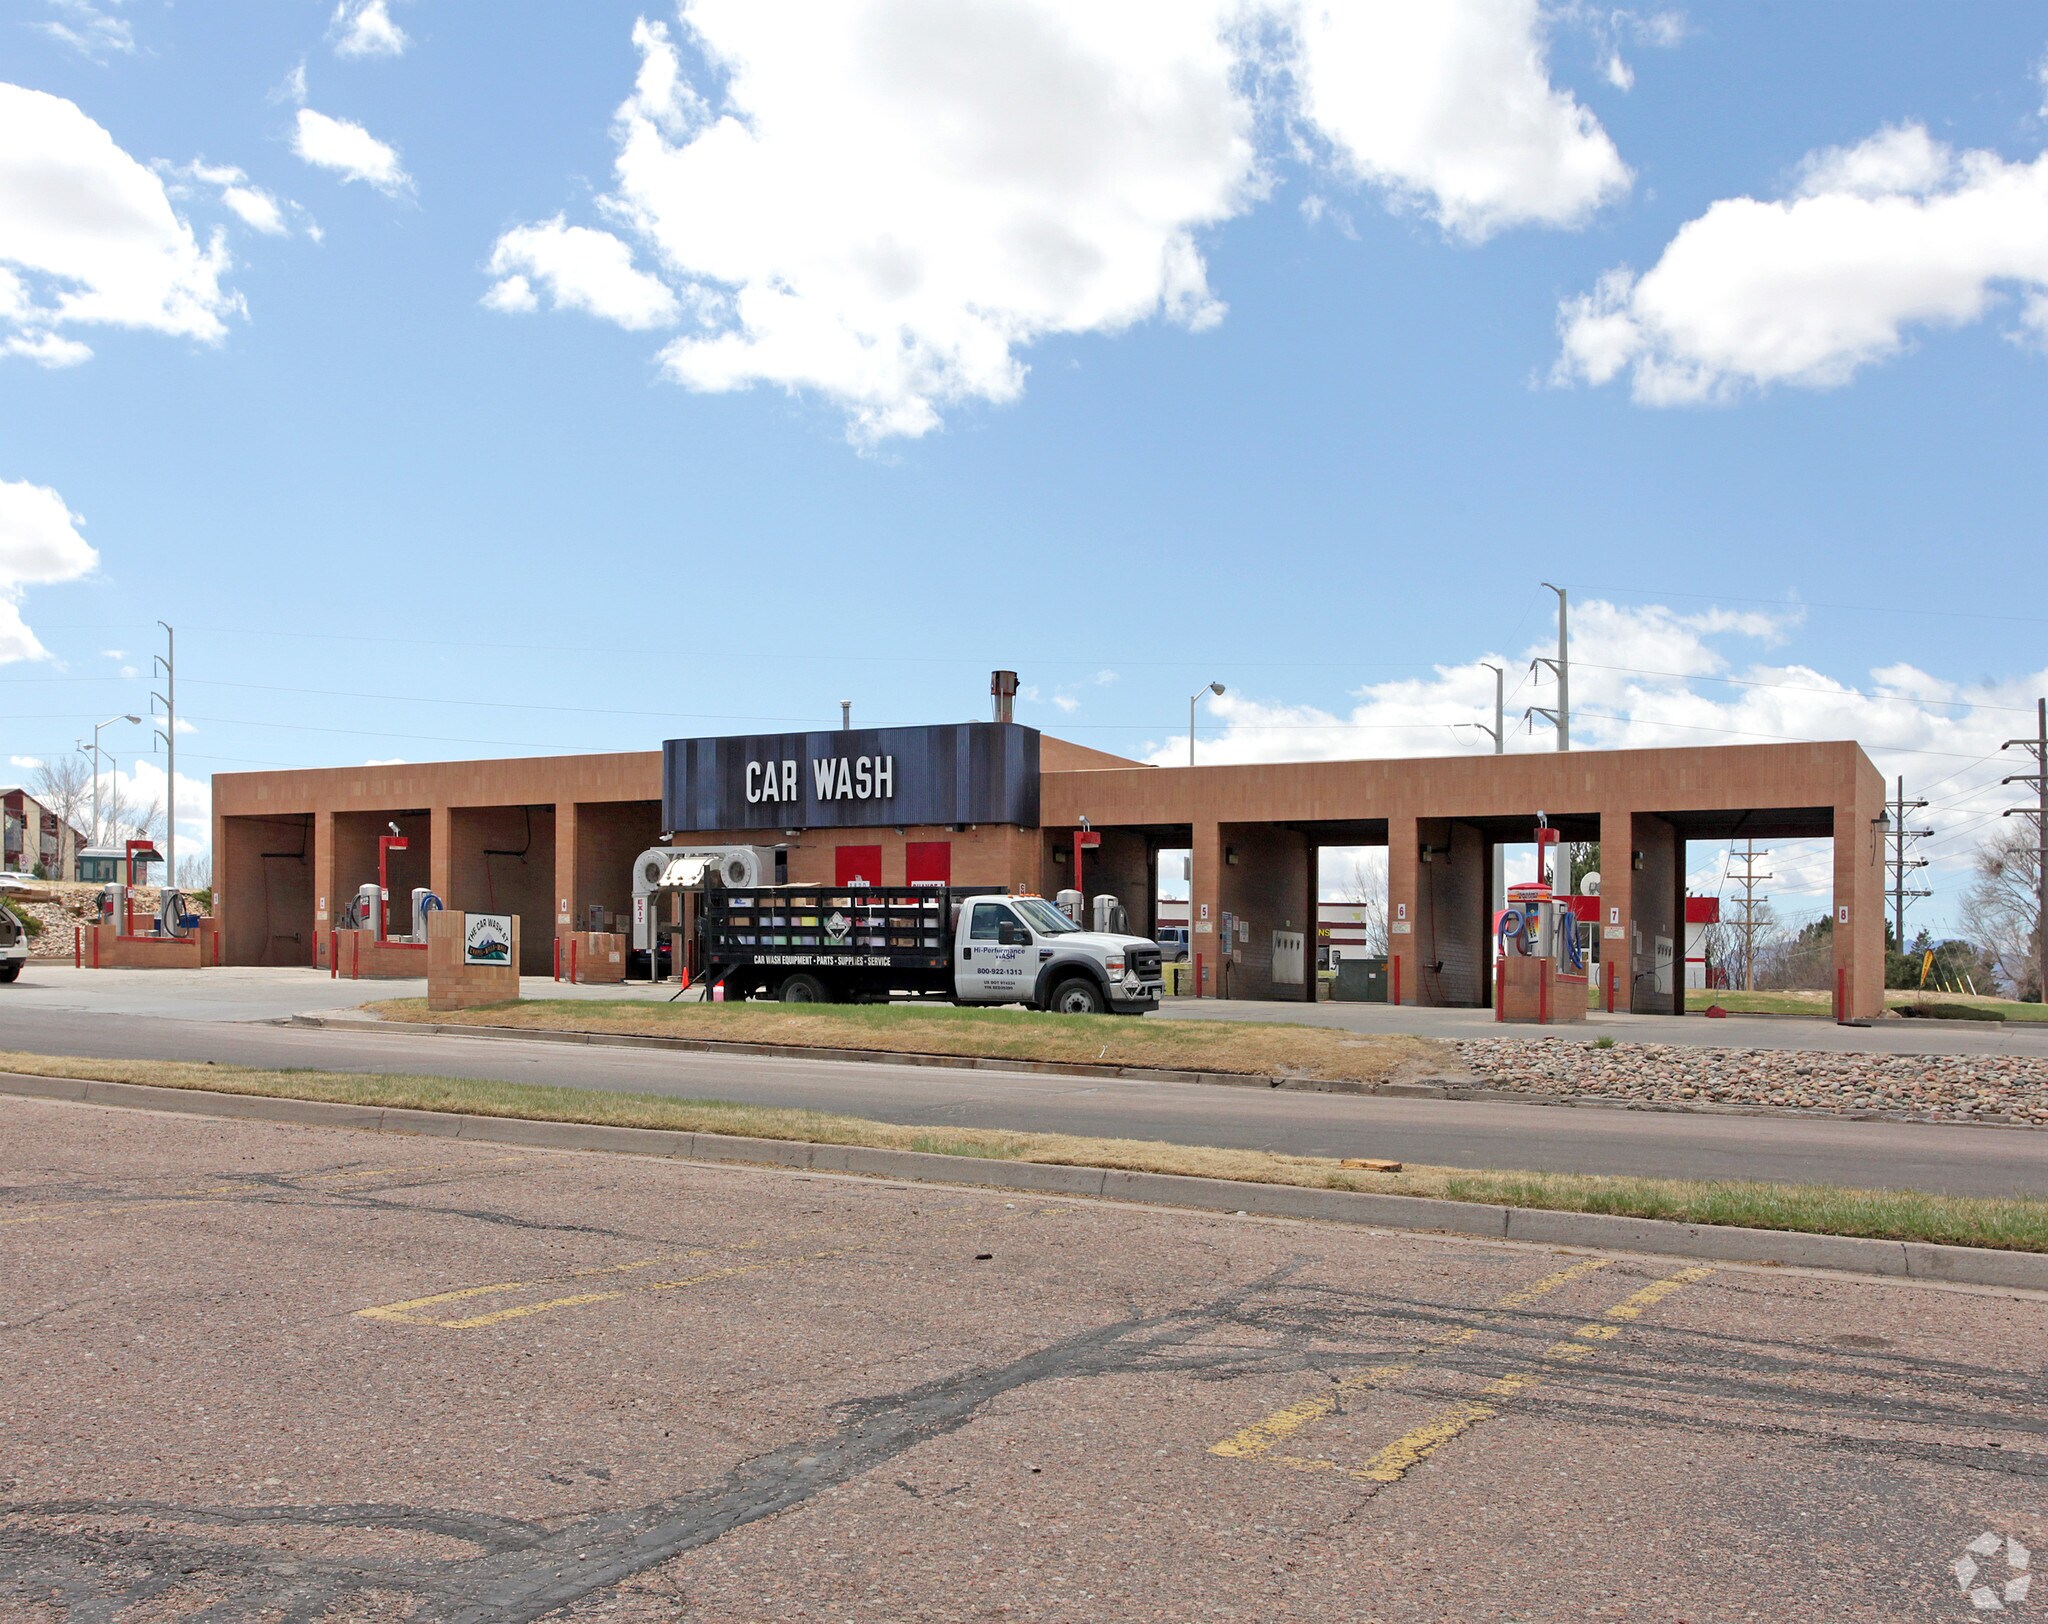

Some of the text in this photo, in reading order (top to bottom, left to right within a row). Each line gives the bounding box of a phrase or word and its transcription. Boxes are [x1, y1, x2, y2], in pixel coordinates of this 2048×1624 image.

[746, 755, 893, 804] CAR WASH
[1840, 909, 1846, 920] 8
[467, 926, 478, 943] THE
[476, 918, 487, 931] CAR
[488, 918, 503, 934] WASH
[753, 955, 766, 965] CAR
[765, 955, 782, 965] WASH
[782, 955, 812, 966] EQUIPMENT
[816, 956, 834, 966] PARTS
[867, 957, 891, 967] SERVICE
